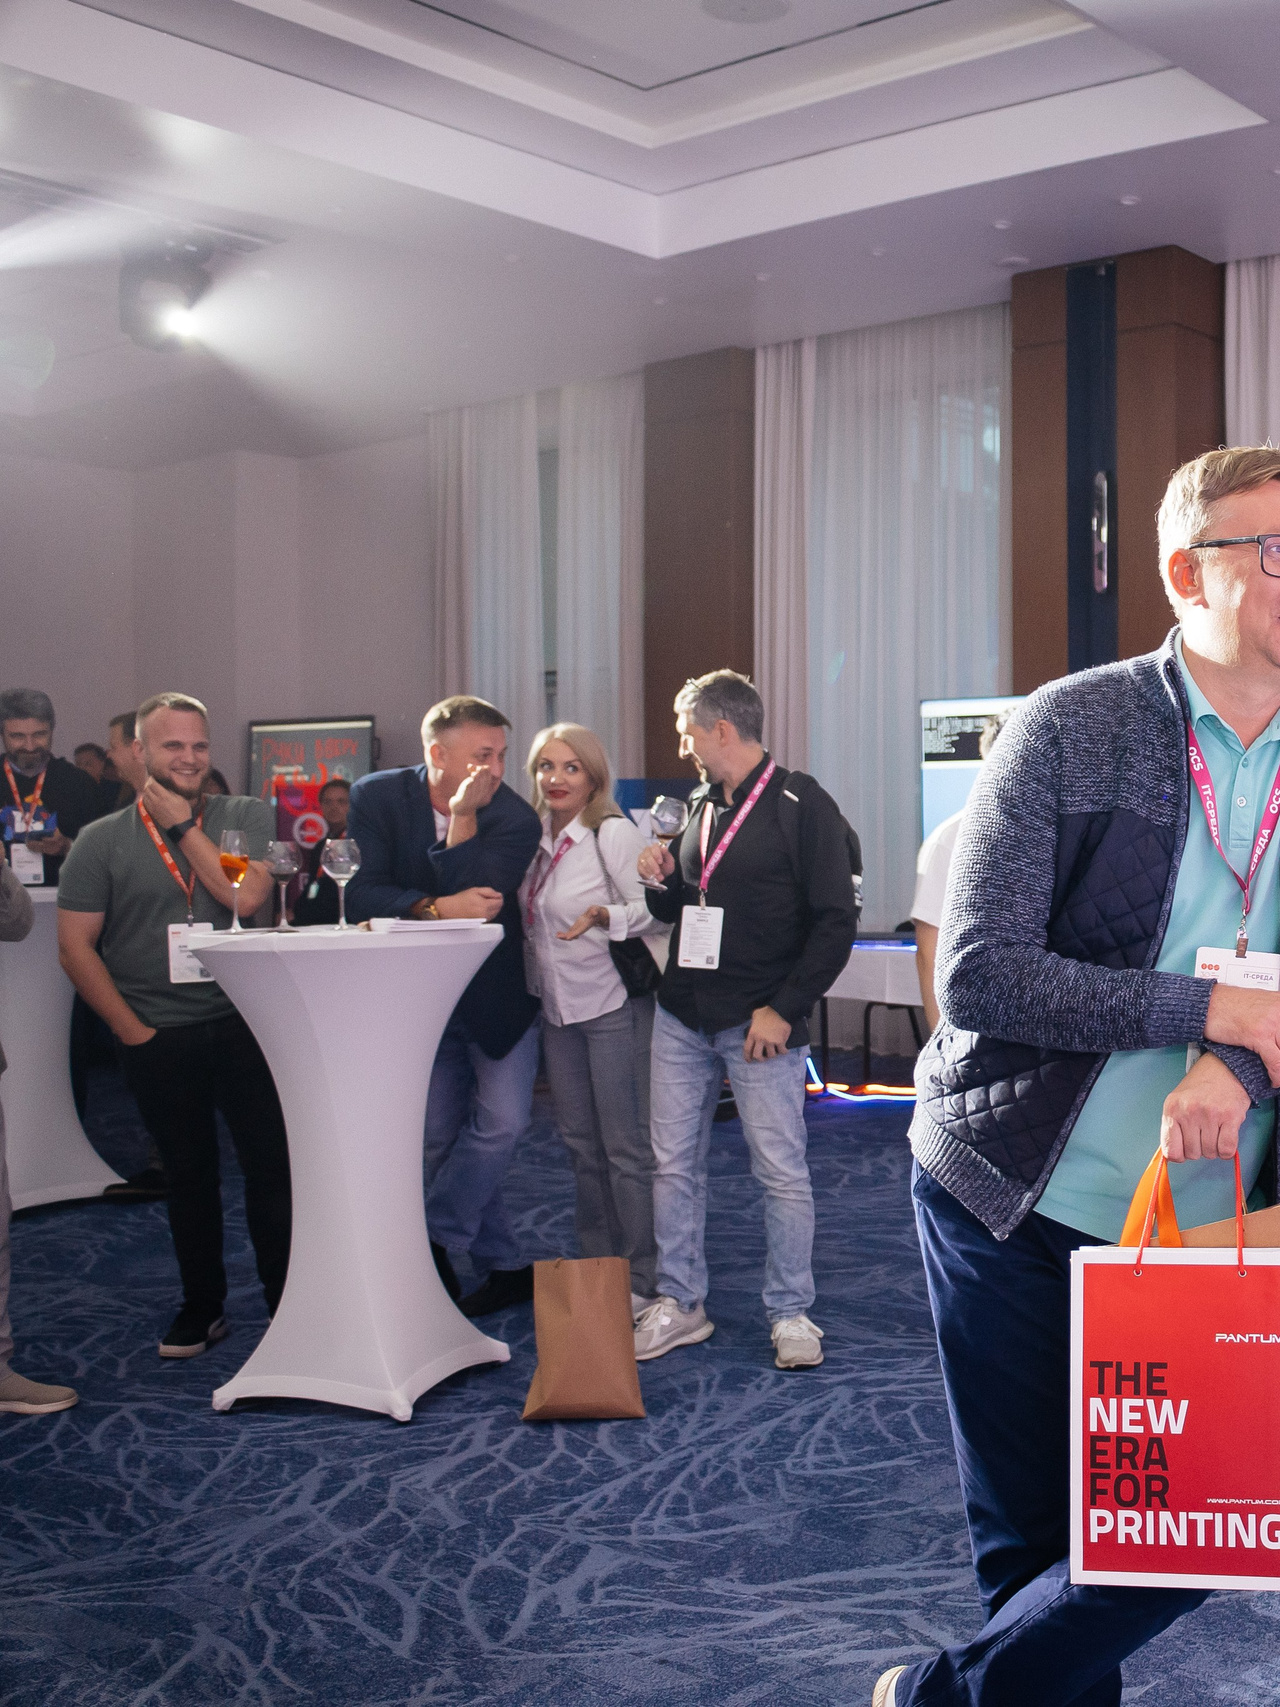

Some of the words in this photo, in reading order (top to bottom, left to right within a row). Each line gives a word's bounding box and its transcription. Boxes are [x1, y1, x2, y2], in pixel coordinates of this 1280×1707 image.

[1189, 746, 1204, 772] OCS
[1243, 973, 1274, 982] IT-СРЕДА
[1089, 1360, 1168, 1396] THE
[1089, 1397, 1189, 1435] NEW
[1089, 1435, 1169, 1471] ERA
[1089, 1472, 1170, 1509] FOR
